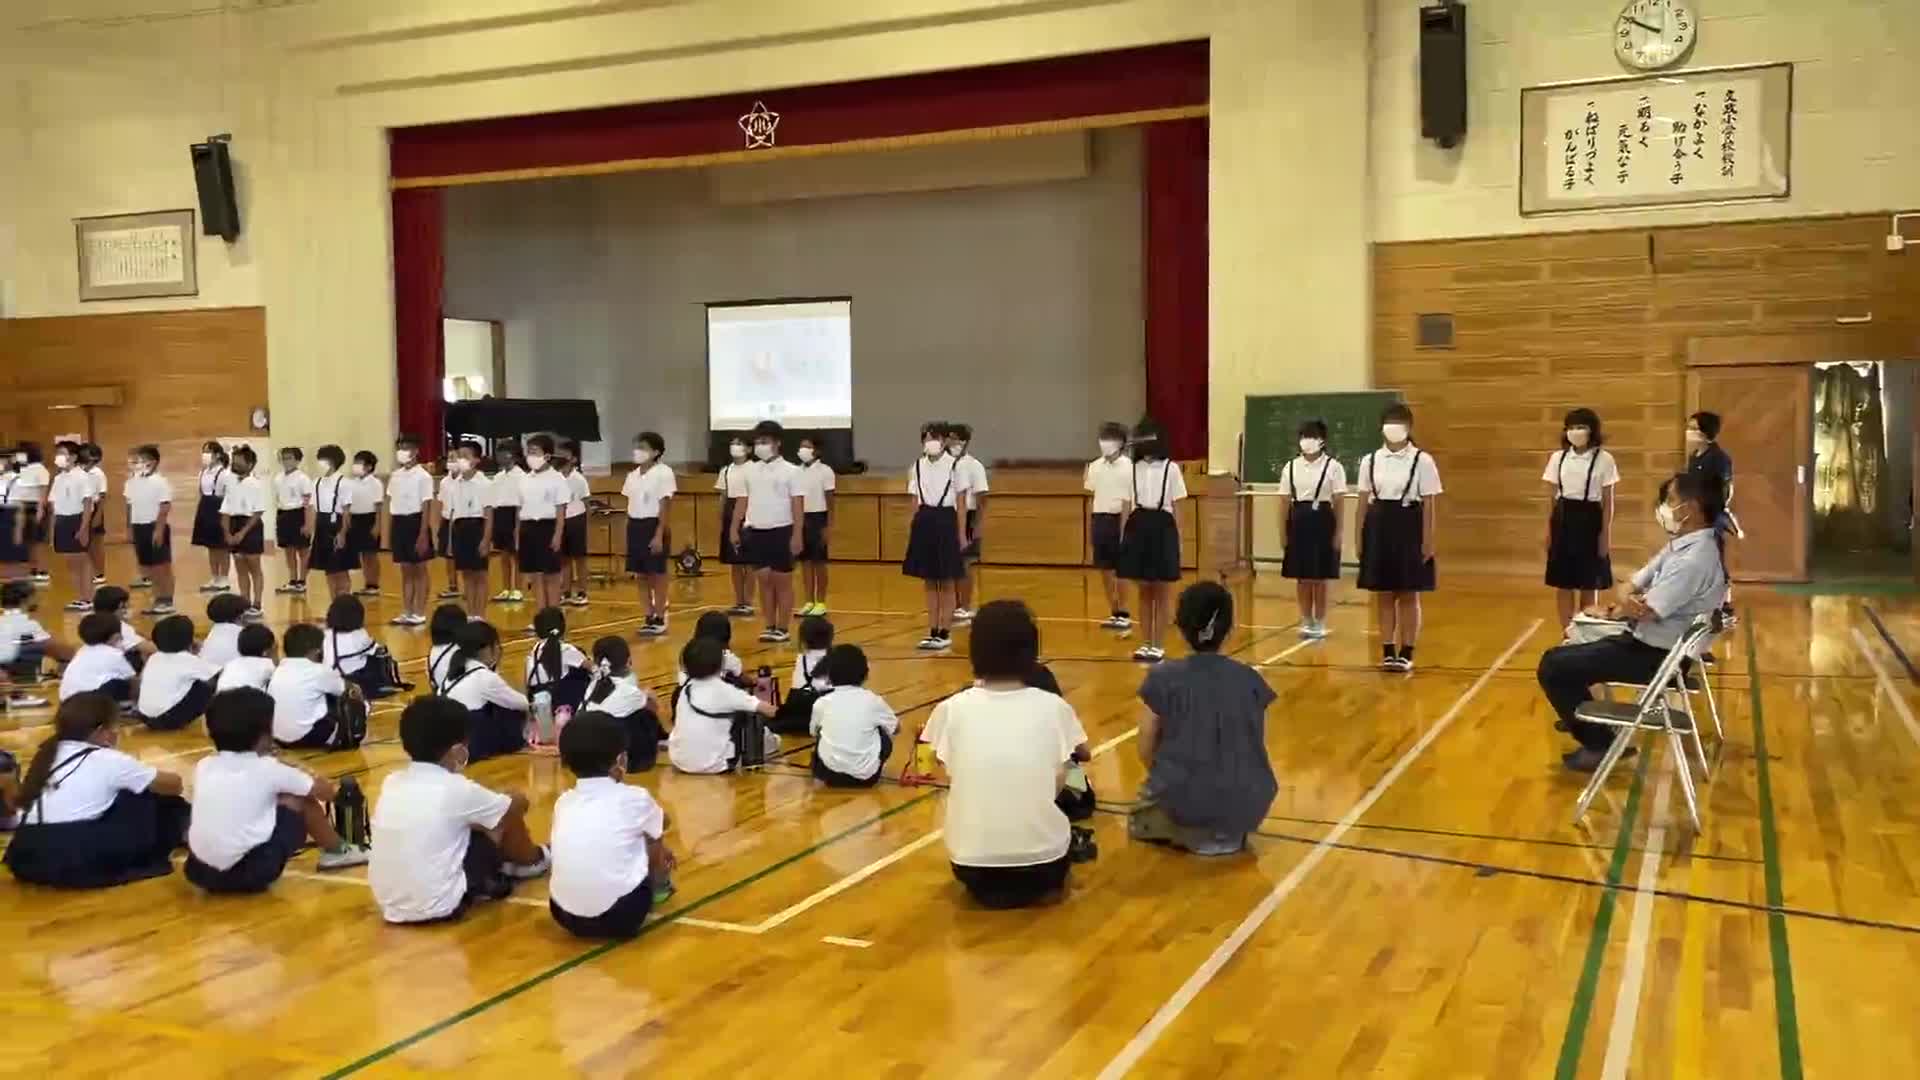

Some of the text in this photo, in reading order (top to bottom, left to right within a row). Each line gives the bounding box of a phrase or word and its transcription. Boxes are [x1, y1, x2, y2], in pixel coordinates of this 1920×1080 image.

[1679, 21, 1688, 31] 3
[1563, 128, 1580, 190] がんばる子
[1616, 124, 1632, 184] 元気な子
[1669, 121, 1688, 185] 助け合う子
